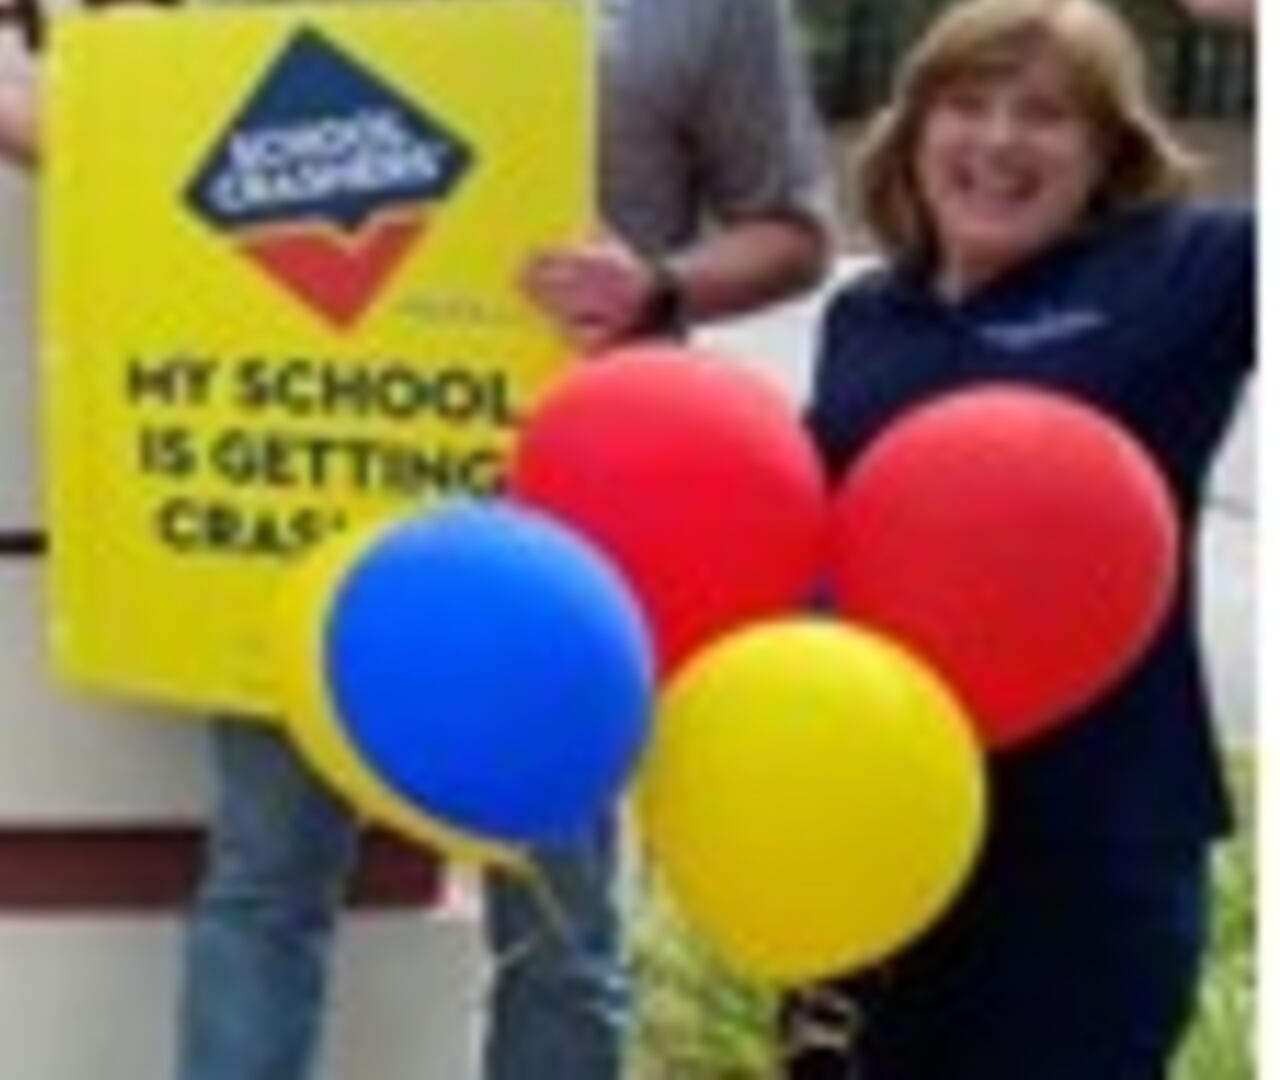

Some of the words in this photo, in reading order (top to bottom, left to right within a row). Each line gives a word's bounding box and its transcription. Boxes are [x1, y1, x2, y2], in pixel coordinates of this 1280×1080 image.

[125, 357, 216, 407] MY
[234, 358, 514, 428] SCHOOL
[140, 428, 198, 478] IS
[210, 430, 510, 497] GETTING
[155, 498, 348, 556] CRAS
